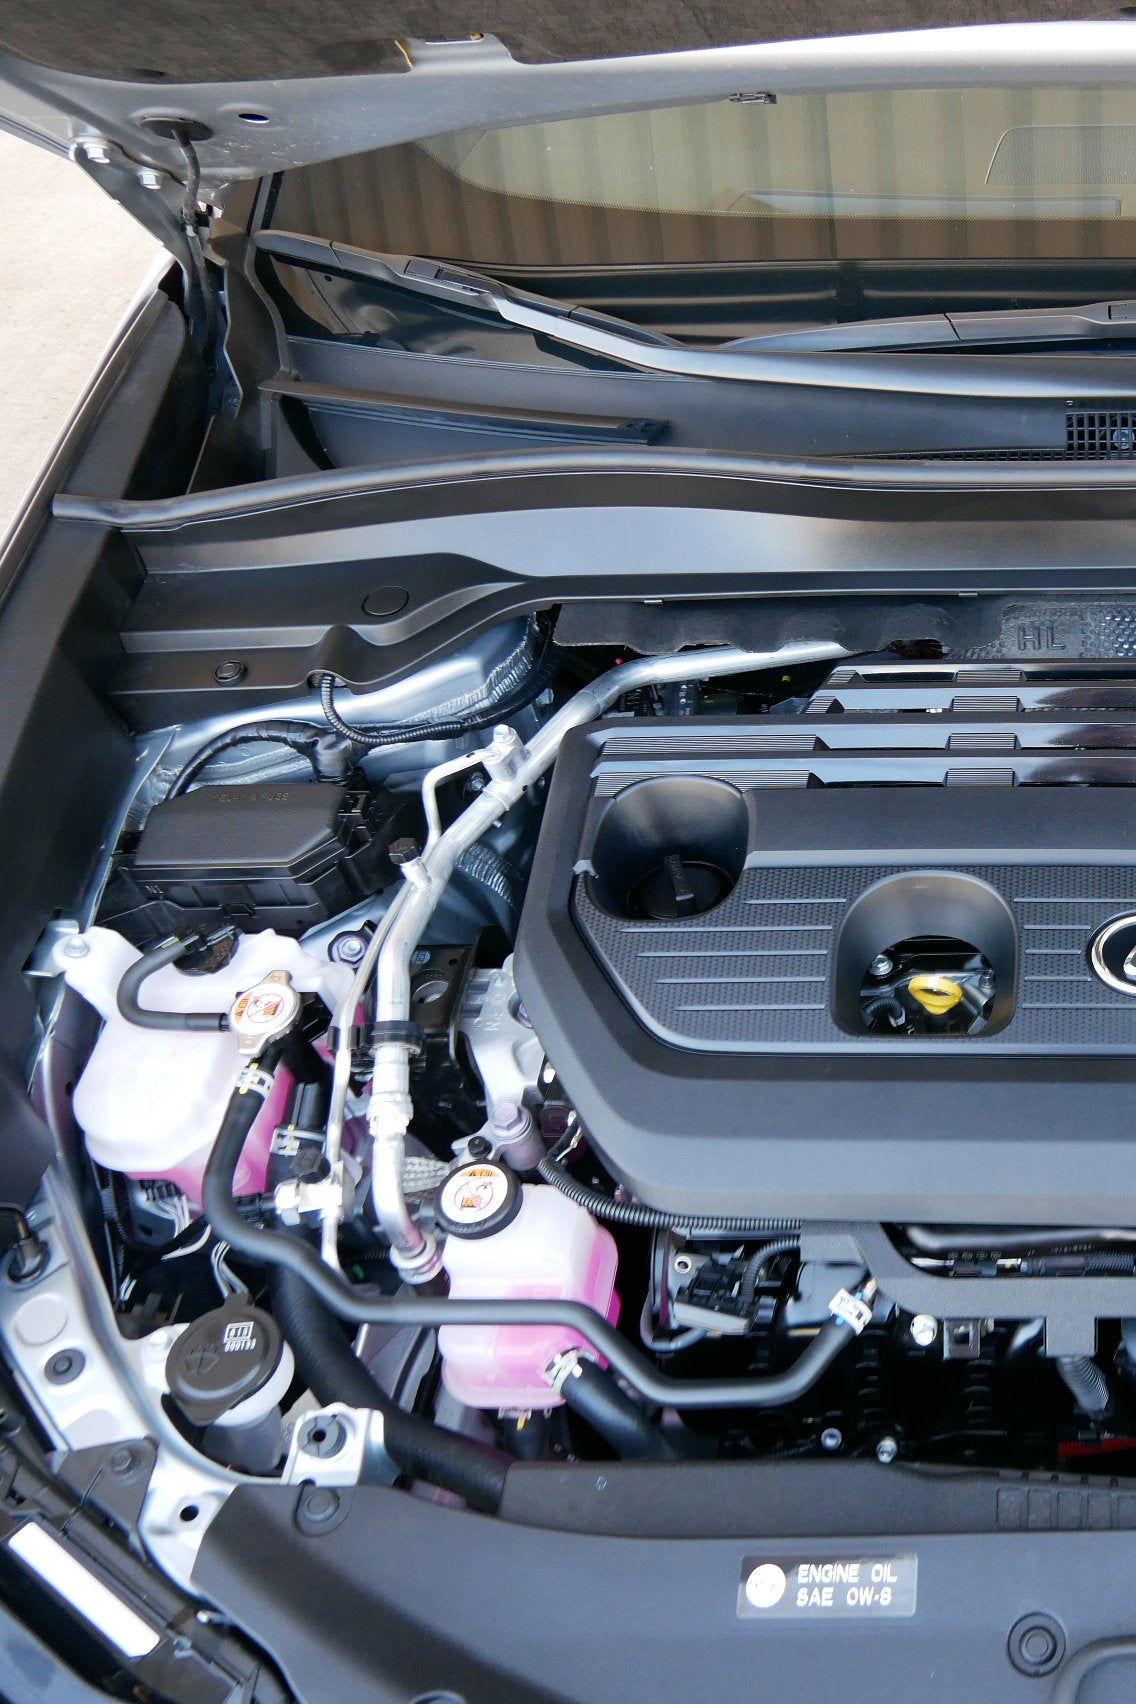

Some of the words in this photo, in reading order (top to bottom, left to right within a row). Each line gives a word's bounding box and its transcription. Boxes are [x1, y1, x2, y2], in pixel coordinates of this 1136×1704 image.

[797, 1563, 860, 1584] ENGINE
[871, 1563, 898, 1583] OIL
[796, 1587, 834, 1607] SAE
